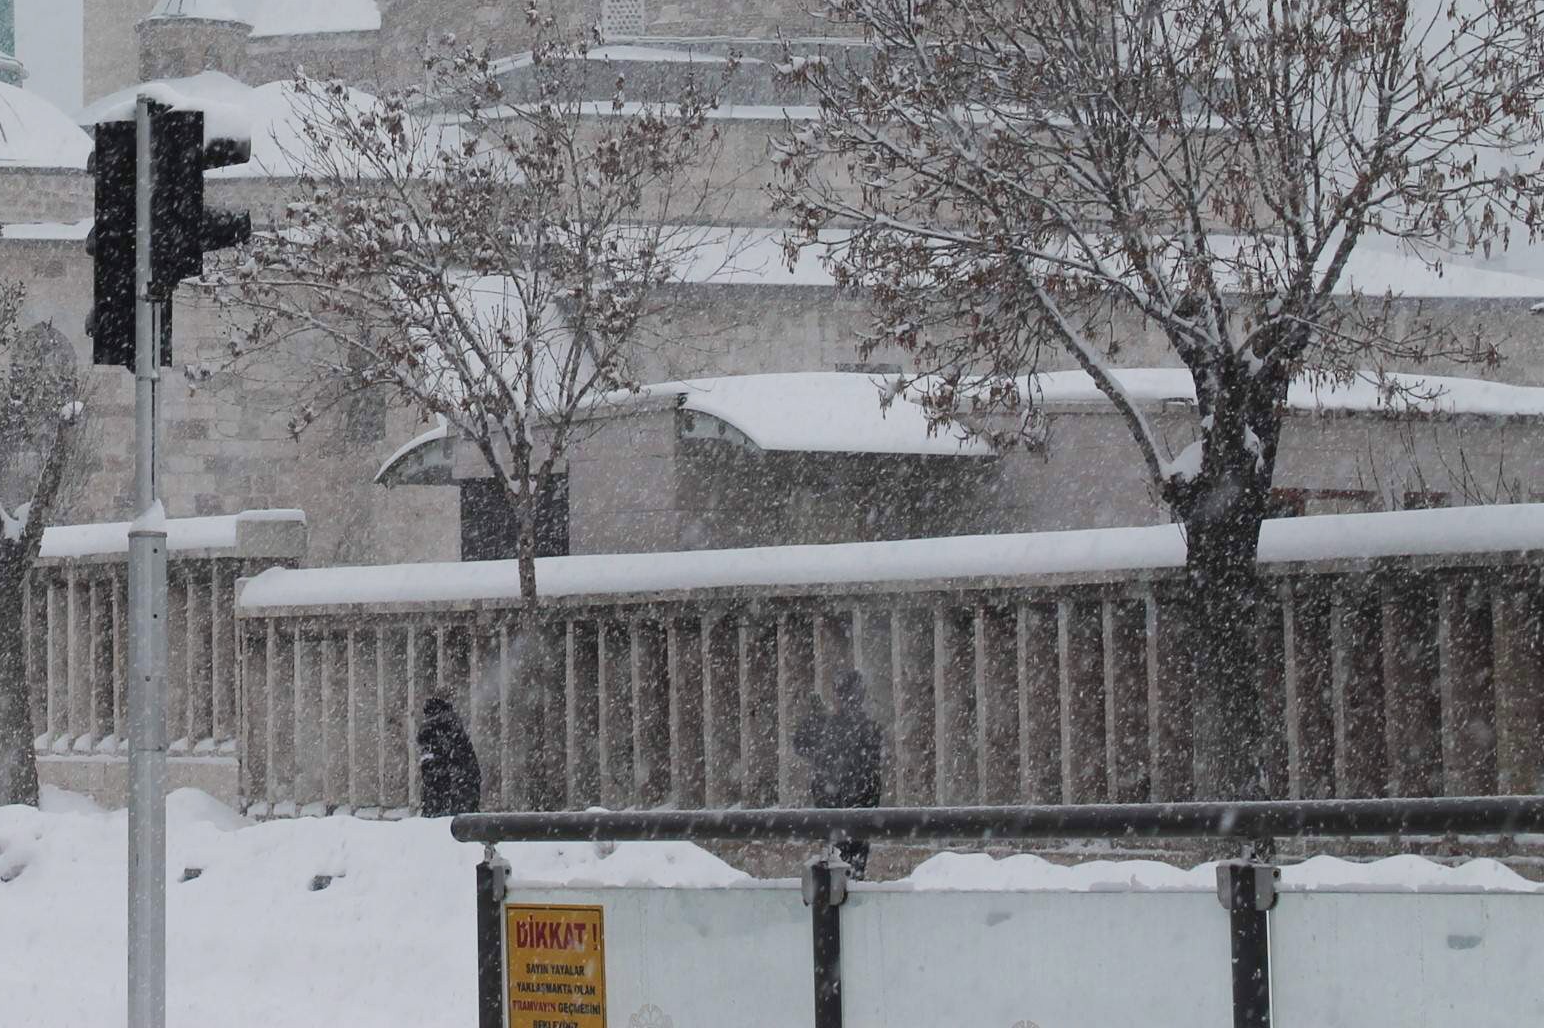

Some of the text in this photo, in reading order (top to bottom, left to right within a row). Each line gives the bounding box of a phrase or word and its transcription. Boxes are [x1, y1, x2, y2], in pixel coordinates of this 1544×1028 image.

[516, 915, 586, 949] DİKKAT
[526, 963, 585, 976] SAYIN YAYALAR
